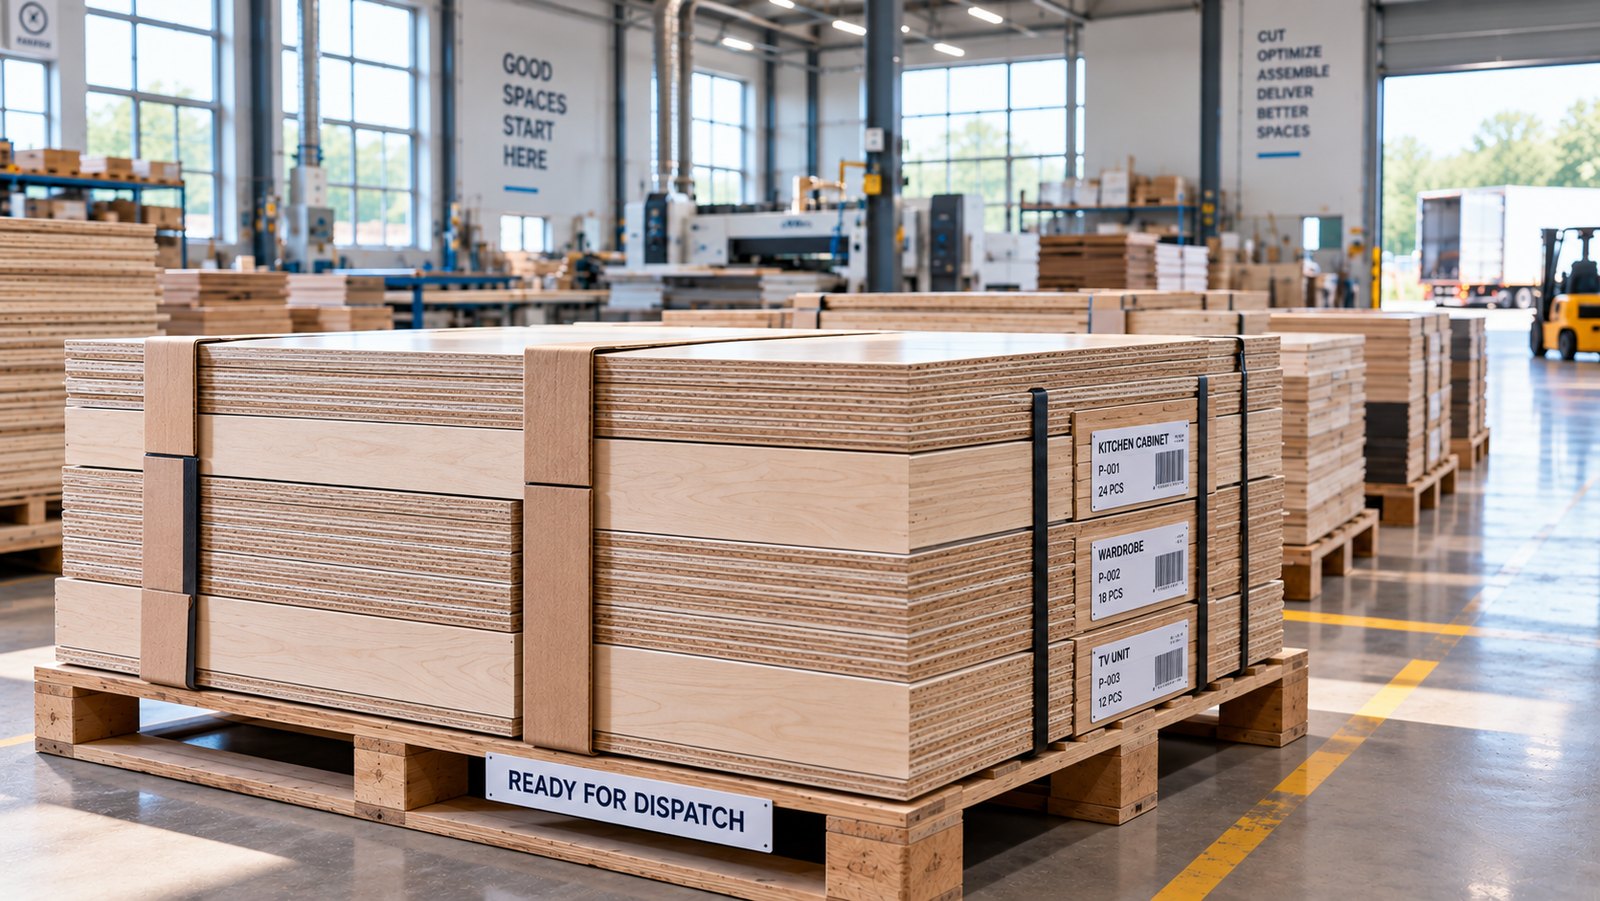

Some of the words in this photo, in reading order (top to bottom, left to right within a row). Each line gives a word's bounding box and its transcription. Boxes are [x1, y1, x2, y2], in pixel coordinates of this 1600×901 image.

[1257, 28, 1286, 43] CUT
[1257, 45, 1322, 62] OPTIMIZE
[503, 52, 553, 82] GOOD
[1257, 64, 1330, 82] ASSEMBLE
[503, 83, 567, 115] SPACES
[1257, 85, 1314, 101] DELIVER
[1257, 105, 1309, 120] BETTER
[503, 114, 555, 141] START
[1257, 124, 1311, 139] SPACES
[503, 145, 548, 171] HERE
[1098, 438, 1134, 454] KITCHEN
[1135, 433, 1170, 449] CABINET
[1098, 462, 1120, 477] P-001
[1098, 485, 1109, 498] 24
[1109, 482, 1124, 495] PCS
[1098, 540, 1144, 561] WARDROBE
[1098, 568, 1121, 584] P-002
[1098, 591, 1107, 604] 18
[1108, 588, 1123, 602] PCS
[1098, 653, 1112, 668] TV
[1111, 647, 1131, 663] UNIT
[1098, 672, 1121, 689] P-003
[1098, 695, 1107, 708] 12
[1107, 691, 1123, 705] PCS
[508, 769, 577, 801] READY
[583, 783, 627, 811] FOR
[634, 792, 745, 833] DISPATCH
